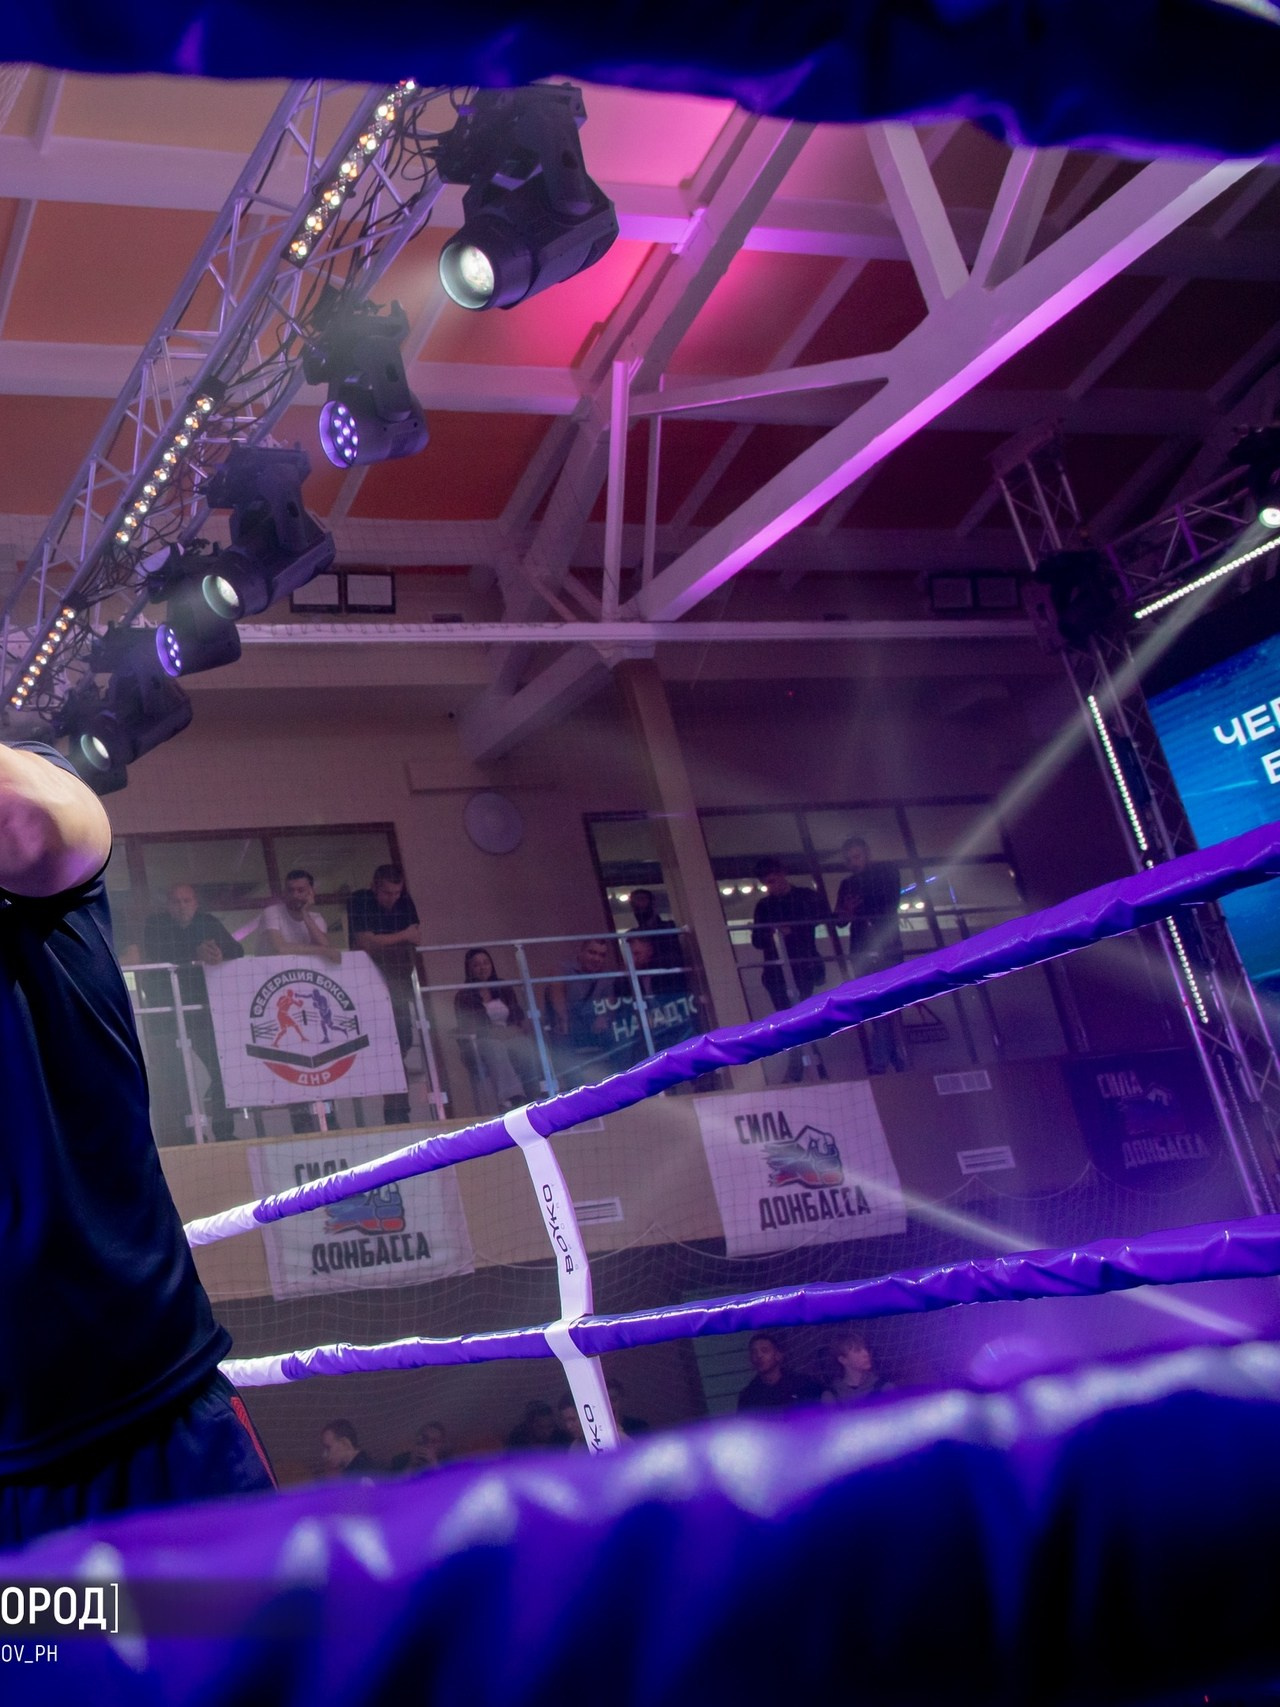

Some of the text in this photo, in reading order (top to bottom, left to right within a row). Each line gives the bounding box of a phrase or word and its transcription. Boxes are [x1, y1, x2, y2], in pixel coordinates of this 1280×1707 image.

[253, 971, 350, 1016] ФЕДЕРАЦИЯ БОКСА
[297, 1071, 332, 1085] ДНР
[1095, 1069, 1144, 1099] СИЛА
[734, 1110, 793, 1145] СИЛА
[1121, 1132, 1210, 1169] ДОНБАССА
[758, 1184, 872, 1232] ДОНБАССА
[542, 1183, 574, 1275] BOYKO
[311, 1231, 432, 1276] ДОНБАССА
